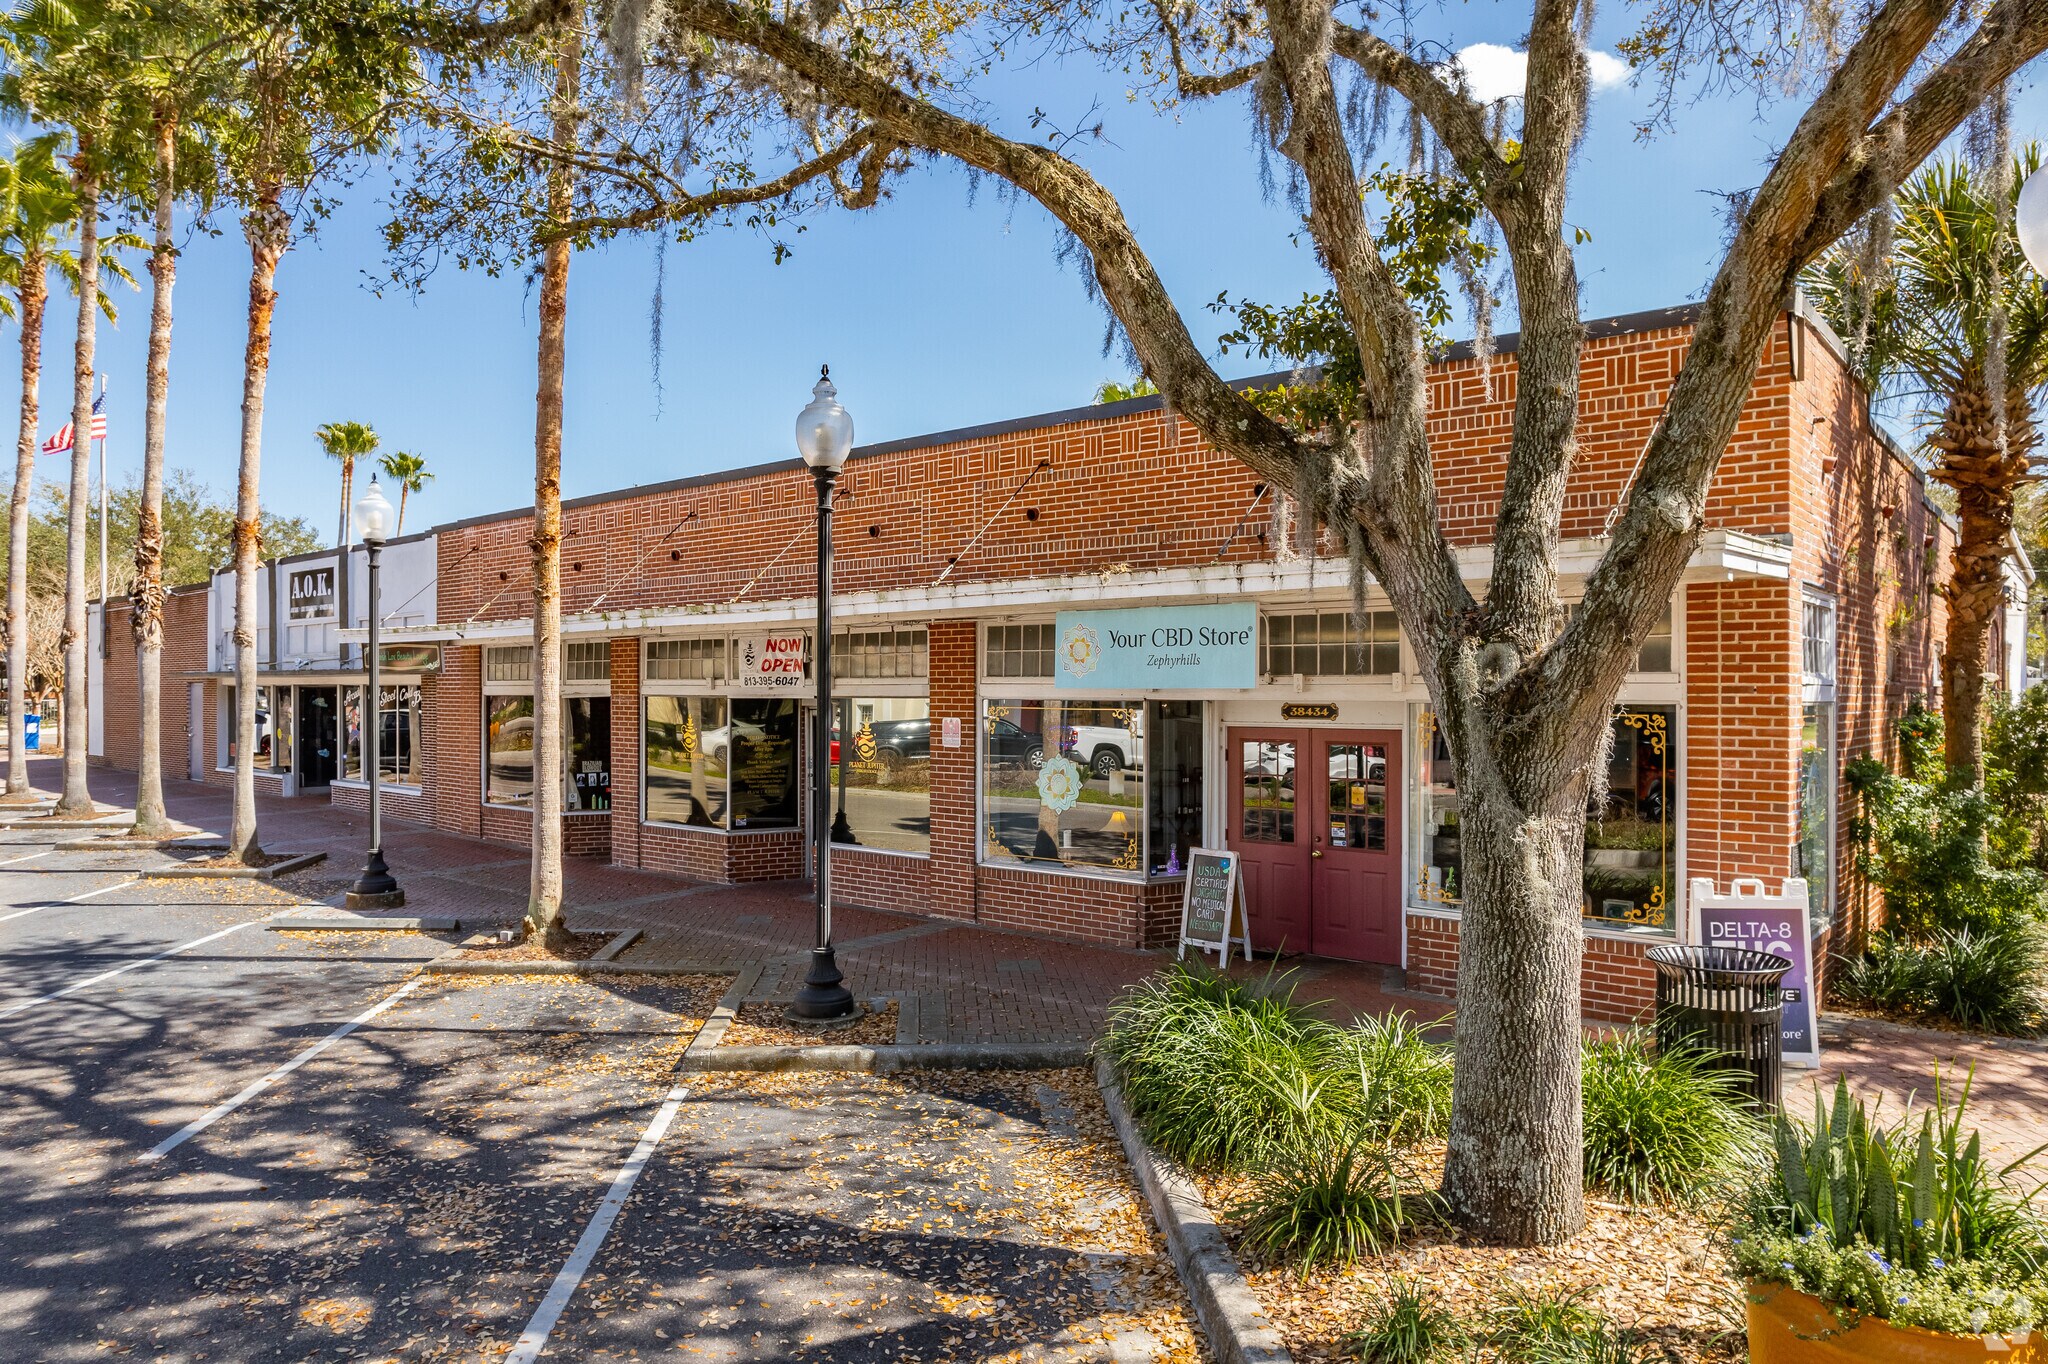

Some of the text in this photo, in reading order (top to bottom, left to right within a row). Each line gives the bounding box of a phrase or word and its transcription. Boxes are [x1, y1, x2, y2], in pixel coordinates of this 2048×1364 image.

[291, 573, 332, 599] A.O.K.
[765, 638, 802, 653] NOW
[1108, 629, 1146, 649] Your
[1151, 628, 1193, 647] CBD
[761, 658, 803, 673] OPEN
[1147, 654, 1201, 670] Zephyrhills
[744, 676, 800, 686] 813-395-6047
[343, 687, 361, 707] Arcad
[1290, 707, 1329, 716] 38434
[1198, 865, 1221, 877] USDA
[1194, 877, 1228, 890] CERTIFIED
[1197, 888, 1225, 900] ORGANIC
[1191, 897, 1227, 911] NO MEDICAL
[1196, 908, 1215, 920] CARD
[1189, 918, 1224, 932] NECESSARY
[1710, 921, 1792, 938] DELTA-8
